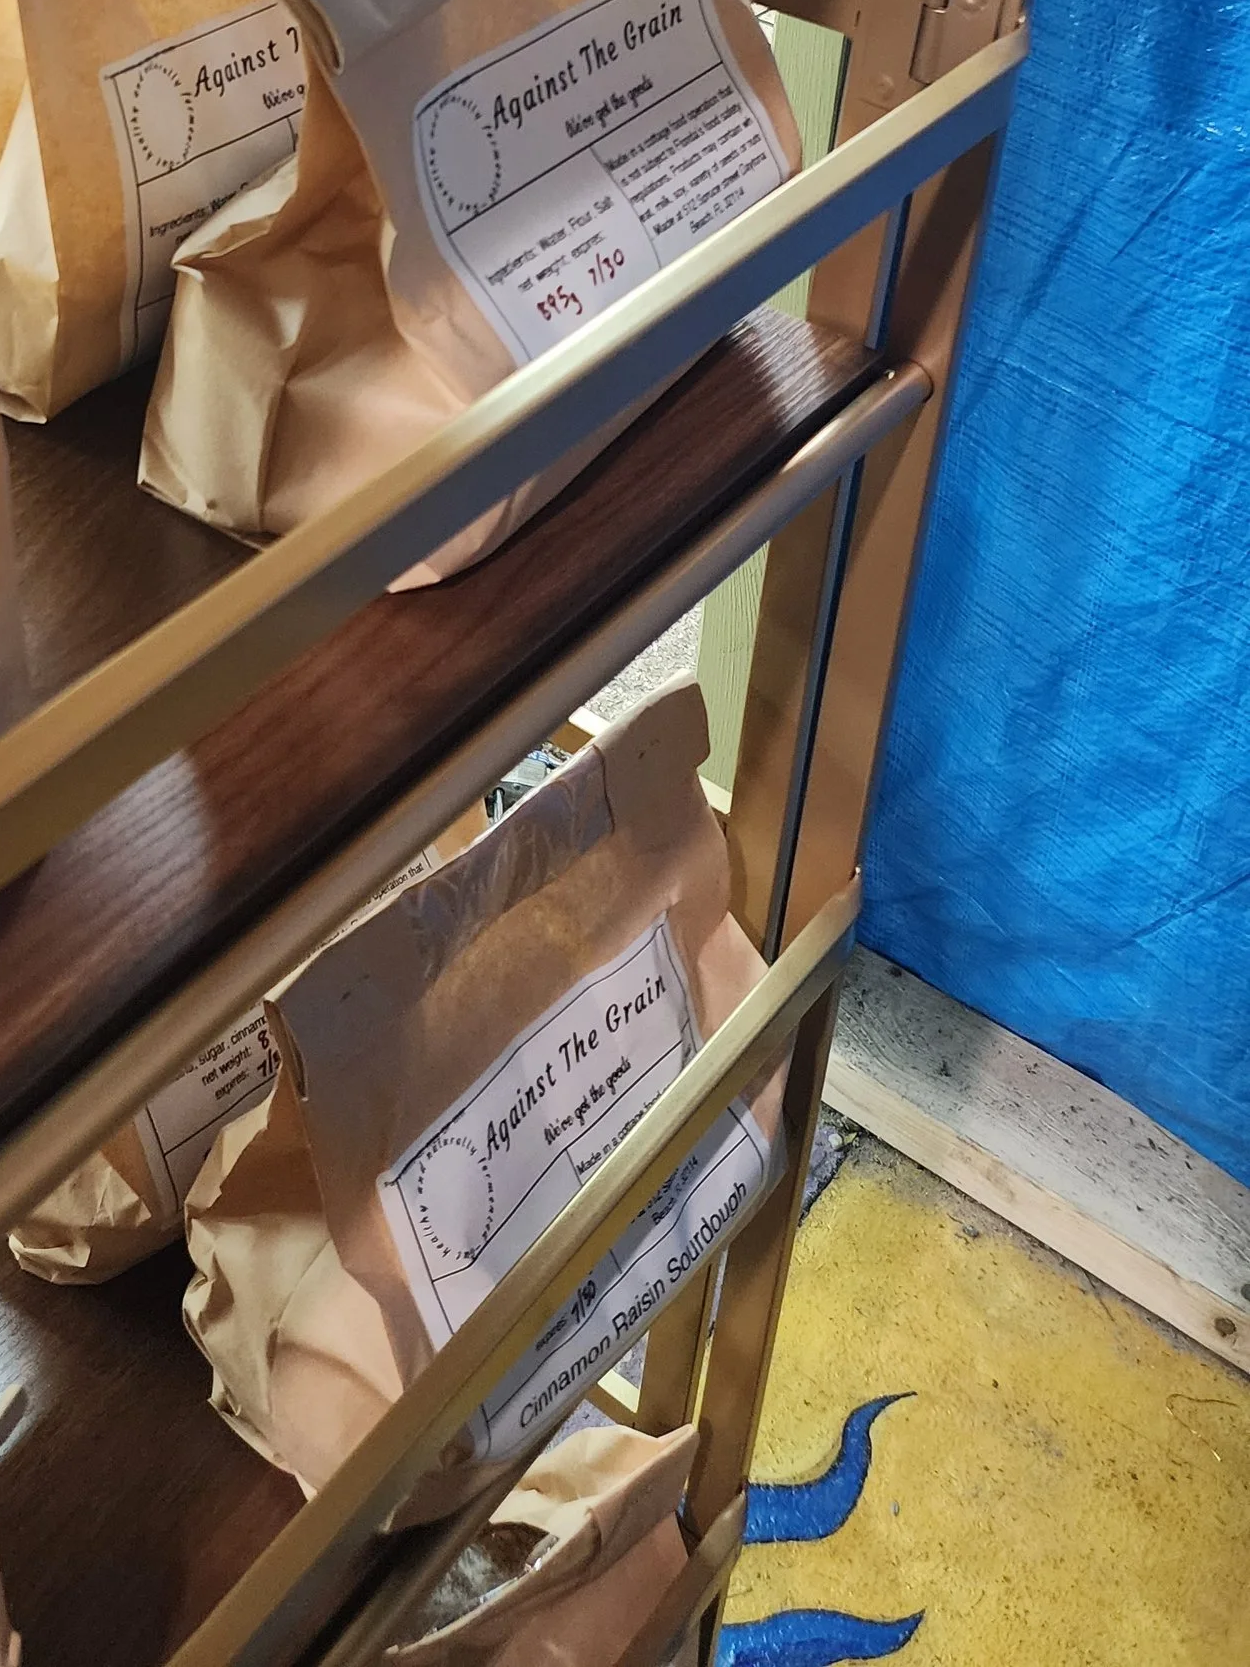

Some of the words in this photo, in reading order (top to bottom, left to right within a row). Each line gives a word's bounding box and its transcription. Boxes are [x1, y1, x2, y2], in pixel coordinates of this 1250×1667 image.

[194, 40, 280, 97] Against
[492, 60, 579, 129] Against
[579, 38, 619, 75] The
[623, 3, 683, 51] Grain
[595, 101, 612, 128] got
[610, 91, 627, 111] the
[627, 75, 654, 109] goods
[588, 248, 625, 287] 7/30
[408, 862, 424, 878] that
[230, 1016, 267, 1045] cinnam
[201, 1069, 219, 1086] net
[218, 1046, 252, 1075] weight:
[214, 1068, 250, 1101] expires:
[486, 1063, 556, 1160] Against
[559, 1032, 599, 1072] The
[605, 975, 667, 1034] Grain
[574, 1094, 593, 1126] got
[590, 1082, 607, 1104] the
[605, 1055, 632, 1096] goods
[576, 1151, 602, 1175] Made
[602, 1143, 612, 1155] in
[612, 1137, 618, 1145] a
[519, 1336, 612, 1429] Cinnamon
[612, 1278, 667, 1339] Raisin
[667, 1181, 748, 1283] Sourdough
